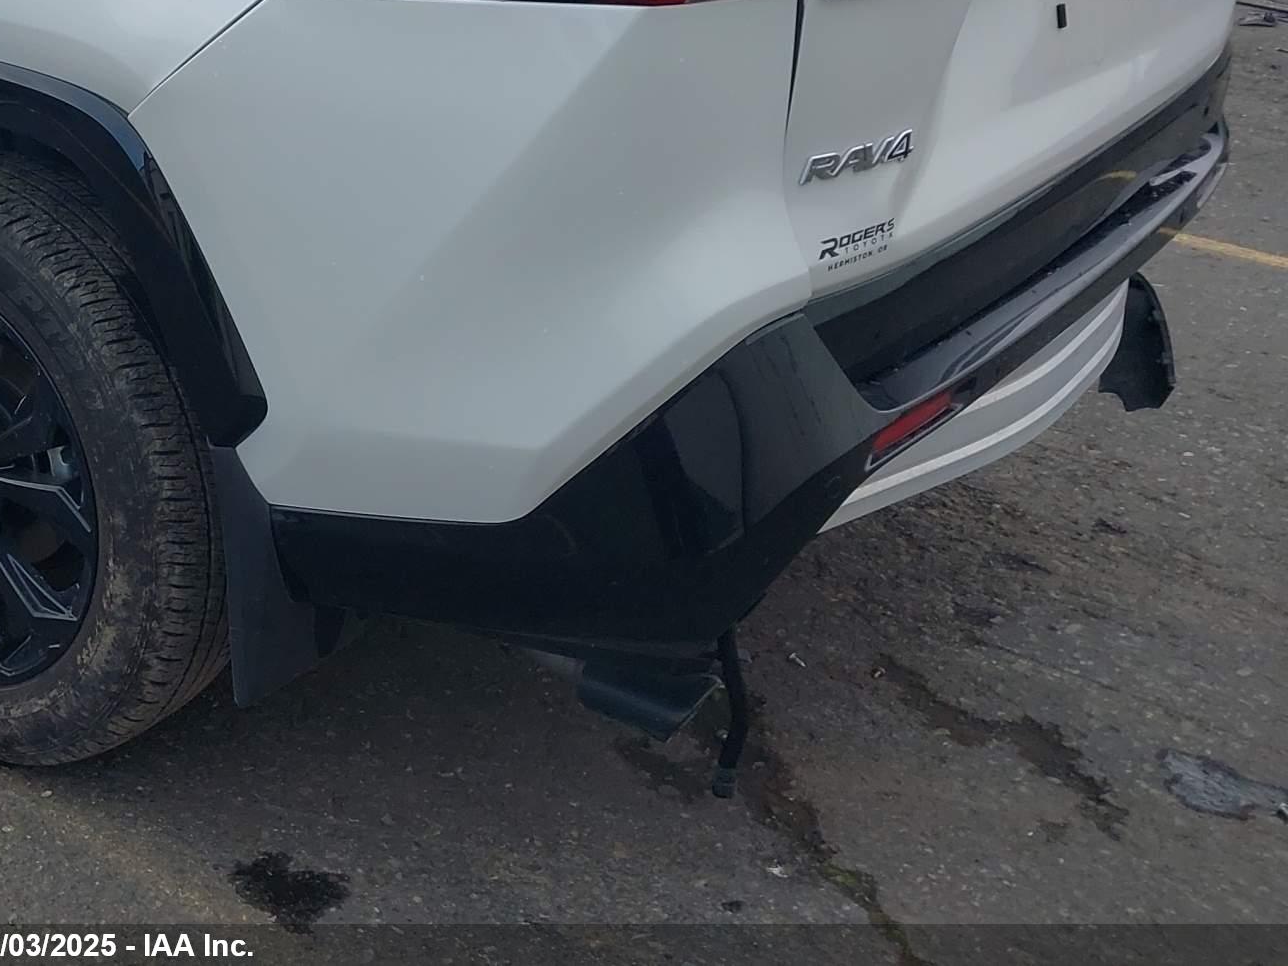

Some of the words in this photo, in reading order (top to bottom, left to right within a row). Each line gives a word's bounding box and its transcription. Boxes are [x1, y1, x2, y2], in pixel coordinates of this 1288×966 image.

[799, 129, 914, 186] RAV4
[818, 218, 895, 260] ROGERS
[844, 232, 894, 254] TOYOTA
